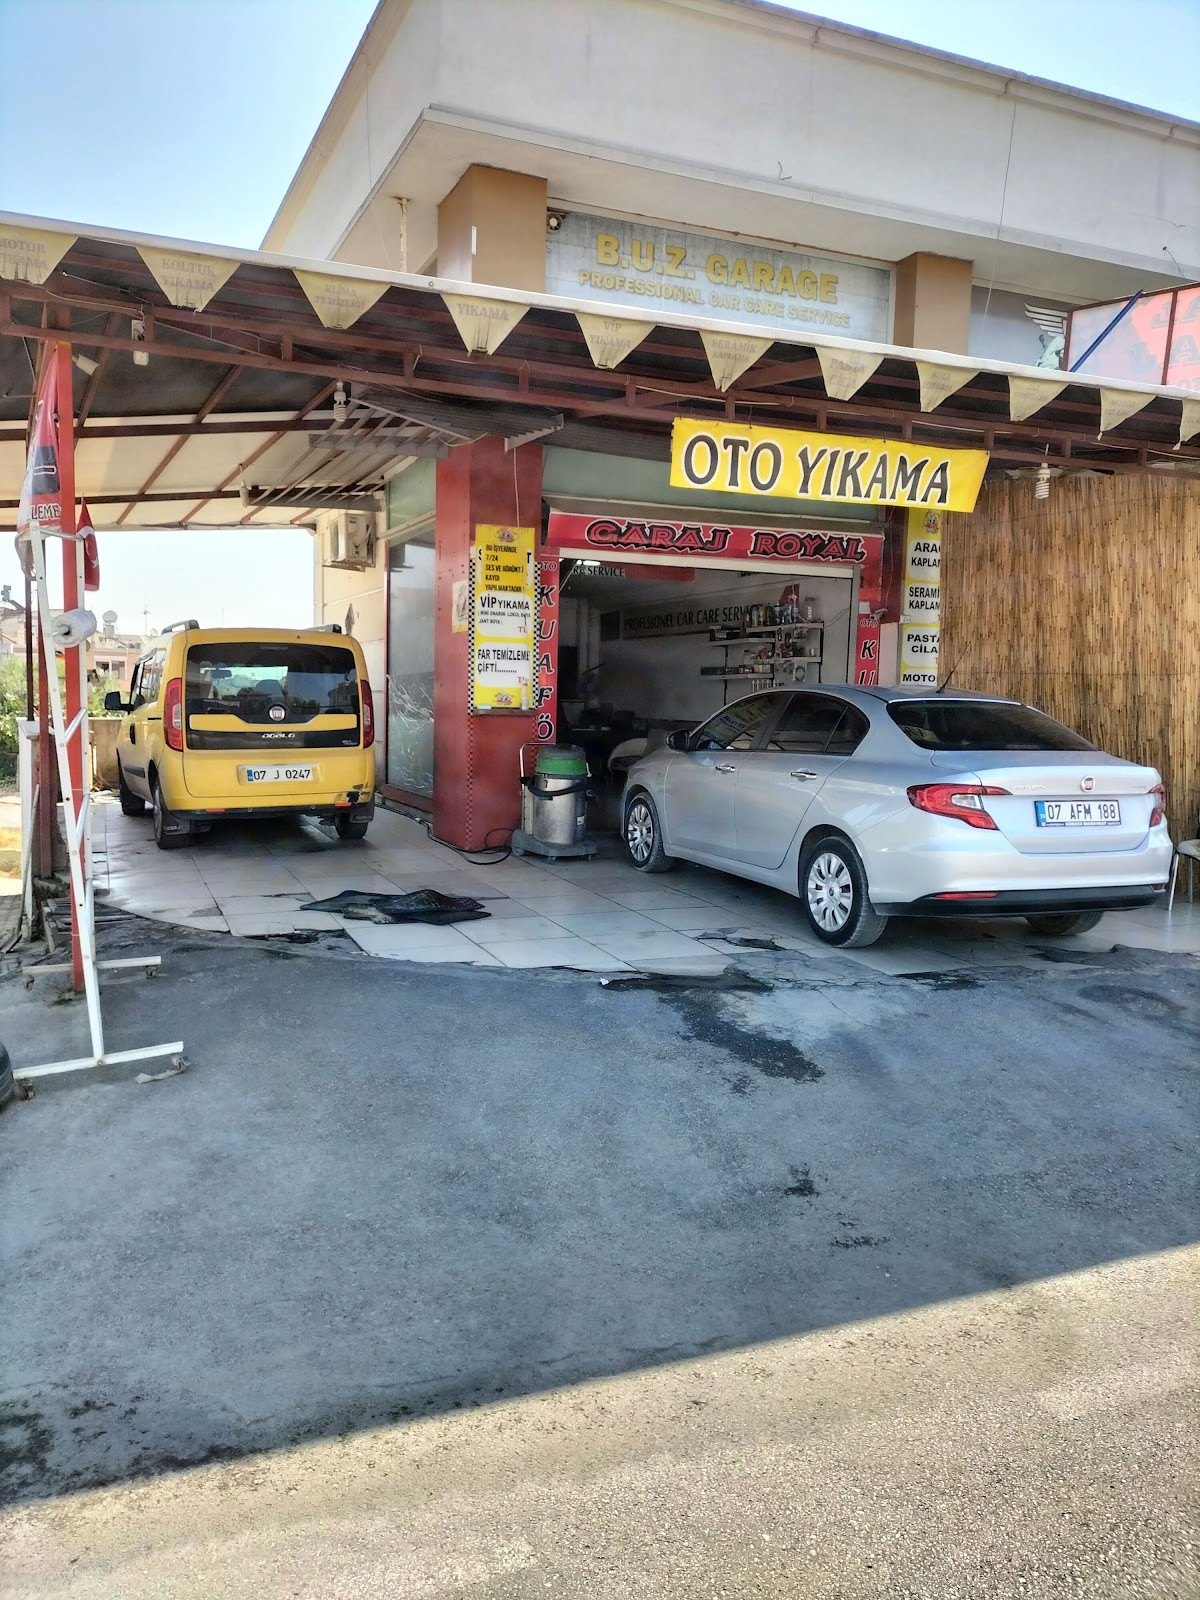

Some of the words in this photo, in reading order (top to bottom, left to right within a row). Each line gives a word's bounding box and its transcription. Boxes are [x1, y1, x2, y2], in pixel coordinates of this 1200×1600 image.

[161, 259, 216, 277] KOLTUK
[596, 233, 695, 280] B.U.Z.
[705, 253, 839, 303] GARAGE
[161, 275, 215, 292] YIKAMA
[578, 269, 705, 305] PROFESSIONAL
[708, 292, 740, 310] CAR
[744, 298, 785, 318] CARE
[788, 306, 851, 328] SERVICE
[457, 303, 508, 321] YIKAMA
[589, 333, 632, 349] YIKAMA
[683, 434, 783, 492] OTO
[797, 446, 950, 504] YIKAMA
[586, 519, 732, 553] GARAJ
[748, 530, 866, 562] ROYAL
[913, 542, 941, 554] ARA
[908, 586, 940, 598] SERAMİ
[480, 594, 497, 608] VİP
[497, 599, 530, 610] YIKAMA
[908, 599, 940, 611] KAPLAM
[676, 611, 694, 627] CAR
[697, 608, 720, 624] CARE
[860, 619, 878, 628] OTO
[477, 649, 491, 660] FAR
[911, 643, 938, 653] CİLA
[902, 673, 936, 682] MOTO
[253, 770, 266, 780] 07
[274, 770, 280, 780] J
[285, 769, 311, 779] 0247
[1047, 804, 1061, 820] 07
[1070, 803, 1092, 820] AFM
[1098, 803, 1116, 820] 188
